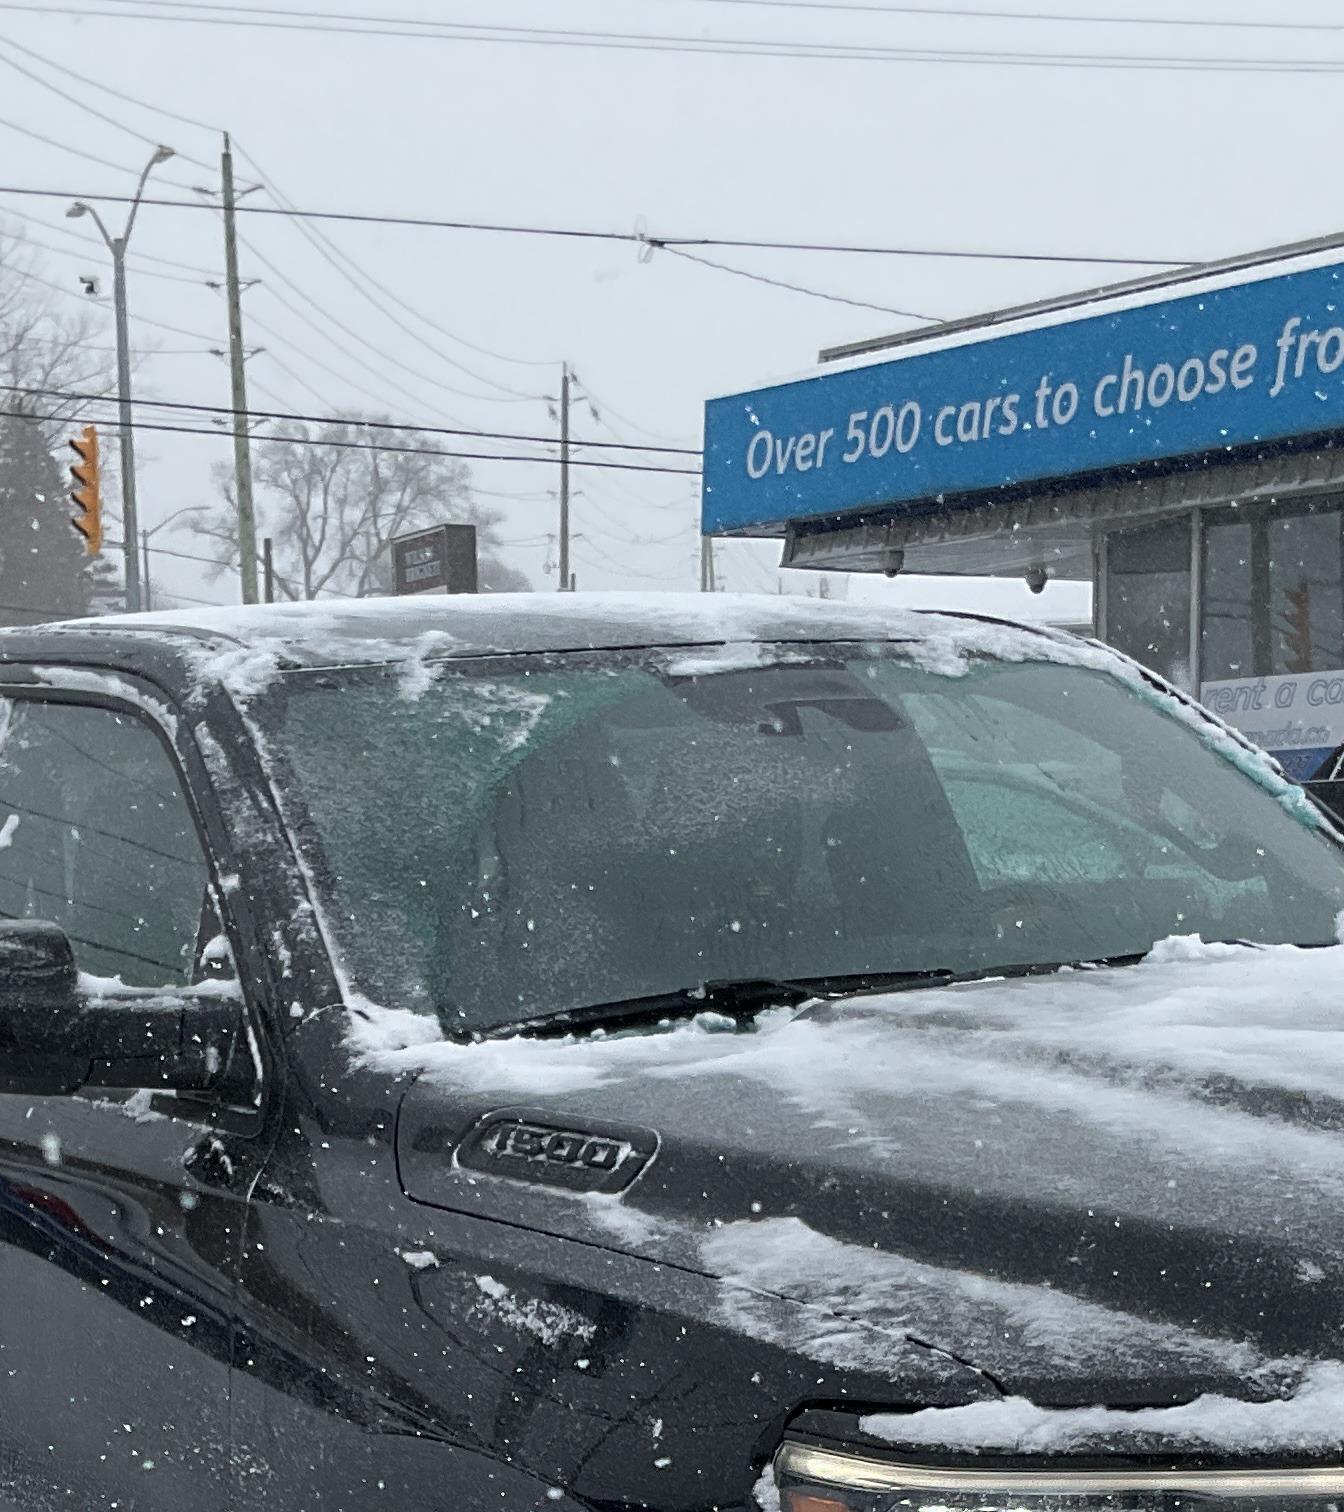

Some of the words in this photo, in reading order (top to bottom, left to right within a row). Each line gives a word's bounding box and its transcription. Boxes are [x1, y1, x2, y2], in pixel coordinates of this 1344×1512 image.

[745, 428, 834, 480] Over
[843, 401, 921, 464] 500
[934, 393, 1020, 447] cars
[1035, 375, 1078, 429] to
[1094, 344, 1257, 418] choose
[1205, 684, 1267, 714] rent
[1274, 682, 1298, 709] a
[481, 1121, 634, 1176] 1500
